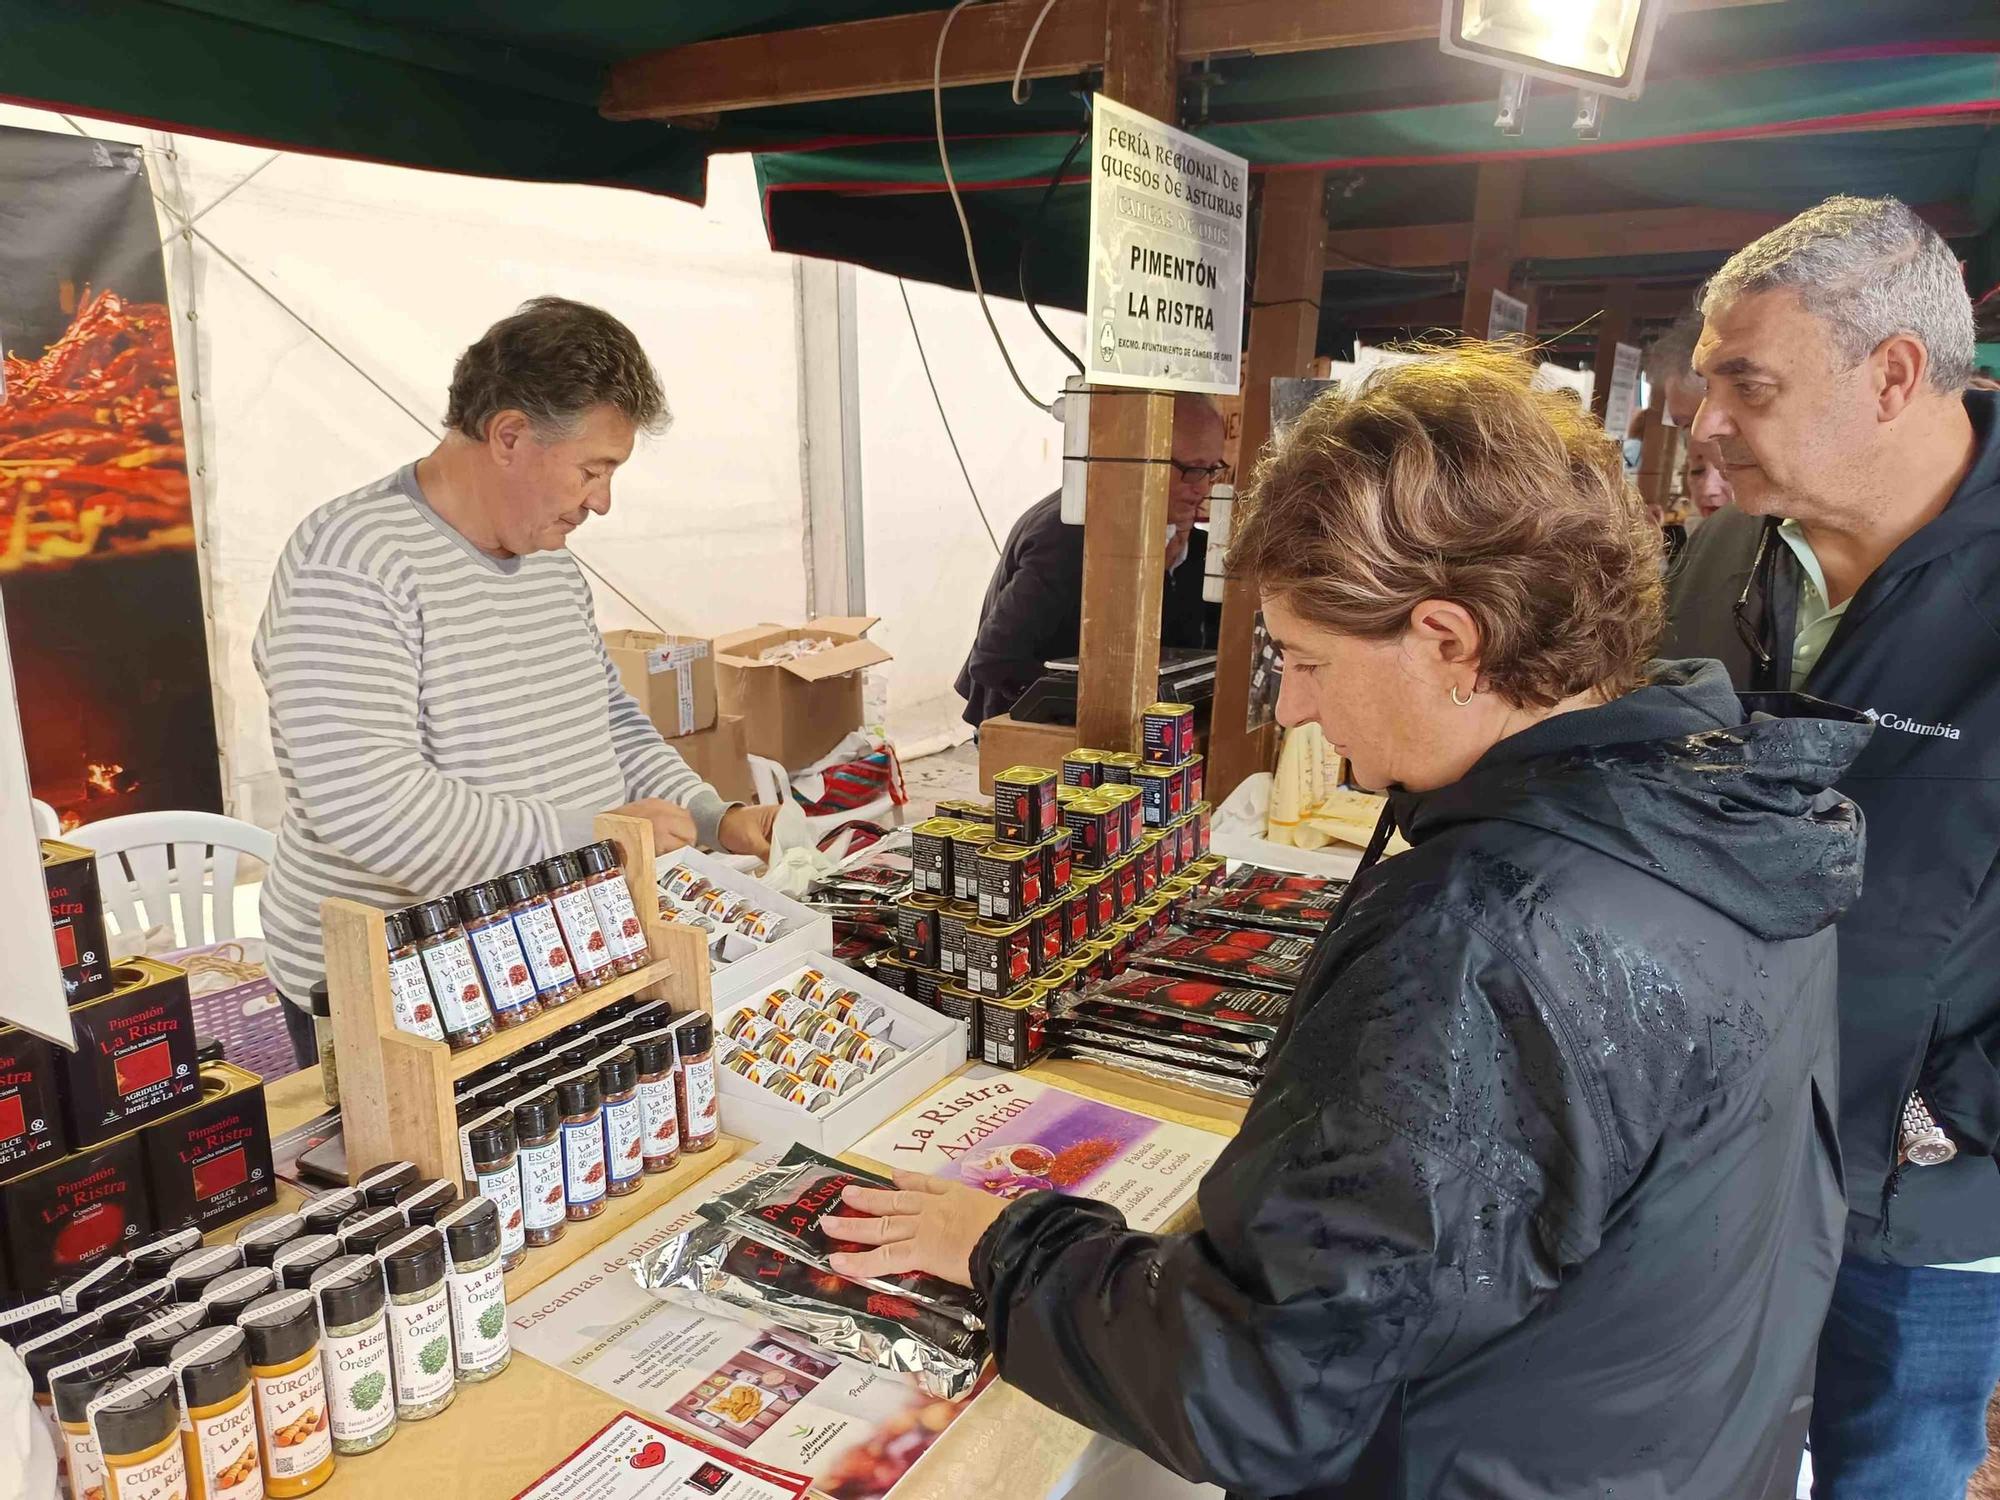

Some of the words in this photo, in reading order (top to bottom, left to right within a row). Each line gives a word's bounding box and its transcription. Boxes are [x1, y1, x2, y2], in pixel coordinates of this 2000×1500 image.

[1131, 245, 1217, 290] PIMENTÓN
[1128, 292, 1150, 320] LA
[1156, 298, 1214, 332] RISTRA
[1880, 713, 1961, 740] Columbia
[108, 1005, 165, 1031] Pimentón
[99, 1034, 126, 1055] La
[129, 1017, 178, 1042] Ristra
[124, 1079, 169, 1102] AGRIDULCE
[151, 1096, 161, 1107] de
[162, 1091, 173, 1102] La
[173, 1080, 194, 1096] Vera
[187, 1114, 240, 1142] Pimentón
[893, 1127, 934, 1153] La
[919, 1081, 1014, 1126] Ristra
[936, 1095, 1033, 1160] Azafrán
[13, 1148, 26, 1160] La
[26, 1138, 52, 1152] Vera
[177, 1143, 202, 1164] La
[206, 1127, 254, 1151] Ristra
[1124, 1142, 1156, 1165] Fabada
[1141, 1148, 1173, 1170] Caldos
[1160, 1152, 1191, 1175] Cocido
[56, 1166, 116, 1197] Pimentón
[41, 1204, 69, 1225] La
[74, 1180, 127, 1208] Ristra
[210, 1188, 236, 1203] DULCE
[226, 1199, 236, 1210] de
[237, 1194, 248, 1205] La
[79, 1244, 108, 1261] DULCE
[464, 1280, 482, 1293] La
[514, 1273, 603, 1331] Escamas
[604, 1254, 625, 1274] de
[405, 1313, 424, 1327] La
[336, 1347, 354, 1360] La
[572, 1351, 594, 1366] Uso
[594, 1342, 607, 1352] en
[607, 1324, 632, 1343] crudo
[631, 1319, 641, 1327] y
[612, 1368, 636, 1385] Sabor
[635, 1353, 657, 1370] suave
[661, 1334, 682, 1351] aroma
[680, 1317, 705, 1335] intenso
[276, 1400, 296, 1414] La
[219, 1437, 240, 1454] La
[799, 1422, 837, 1457] Alimentos
[550, 1481, 565, 1494] que
[564, 1474, 573, 1483] el
[572, 1450, 602, 1477] pimentón
[602, 1431, 625, 1453] picante
[624, 1424, 633, 1433] es
[559, 1466, 597, 1498] beneficioso
[597, 1453, 613, 1469] para
[610, 1446, 620, 1456] la
[618, 1429, 638, 1449] salud?
